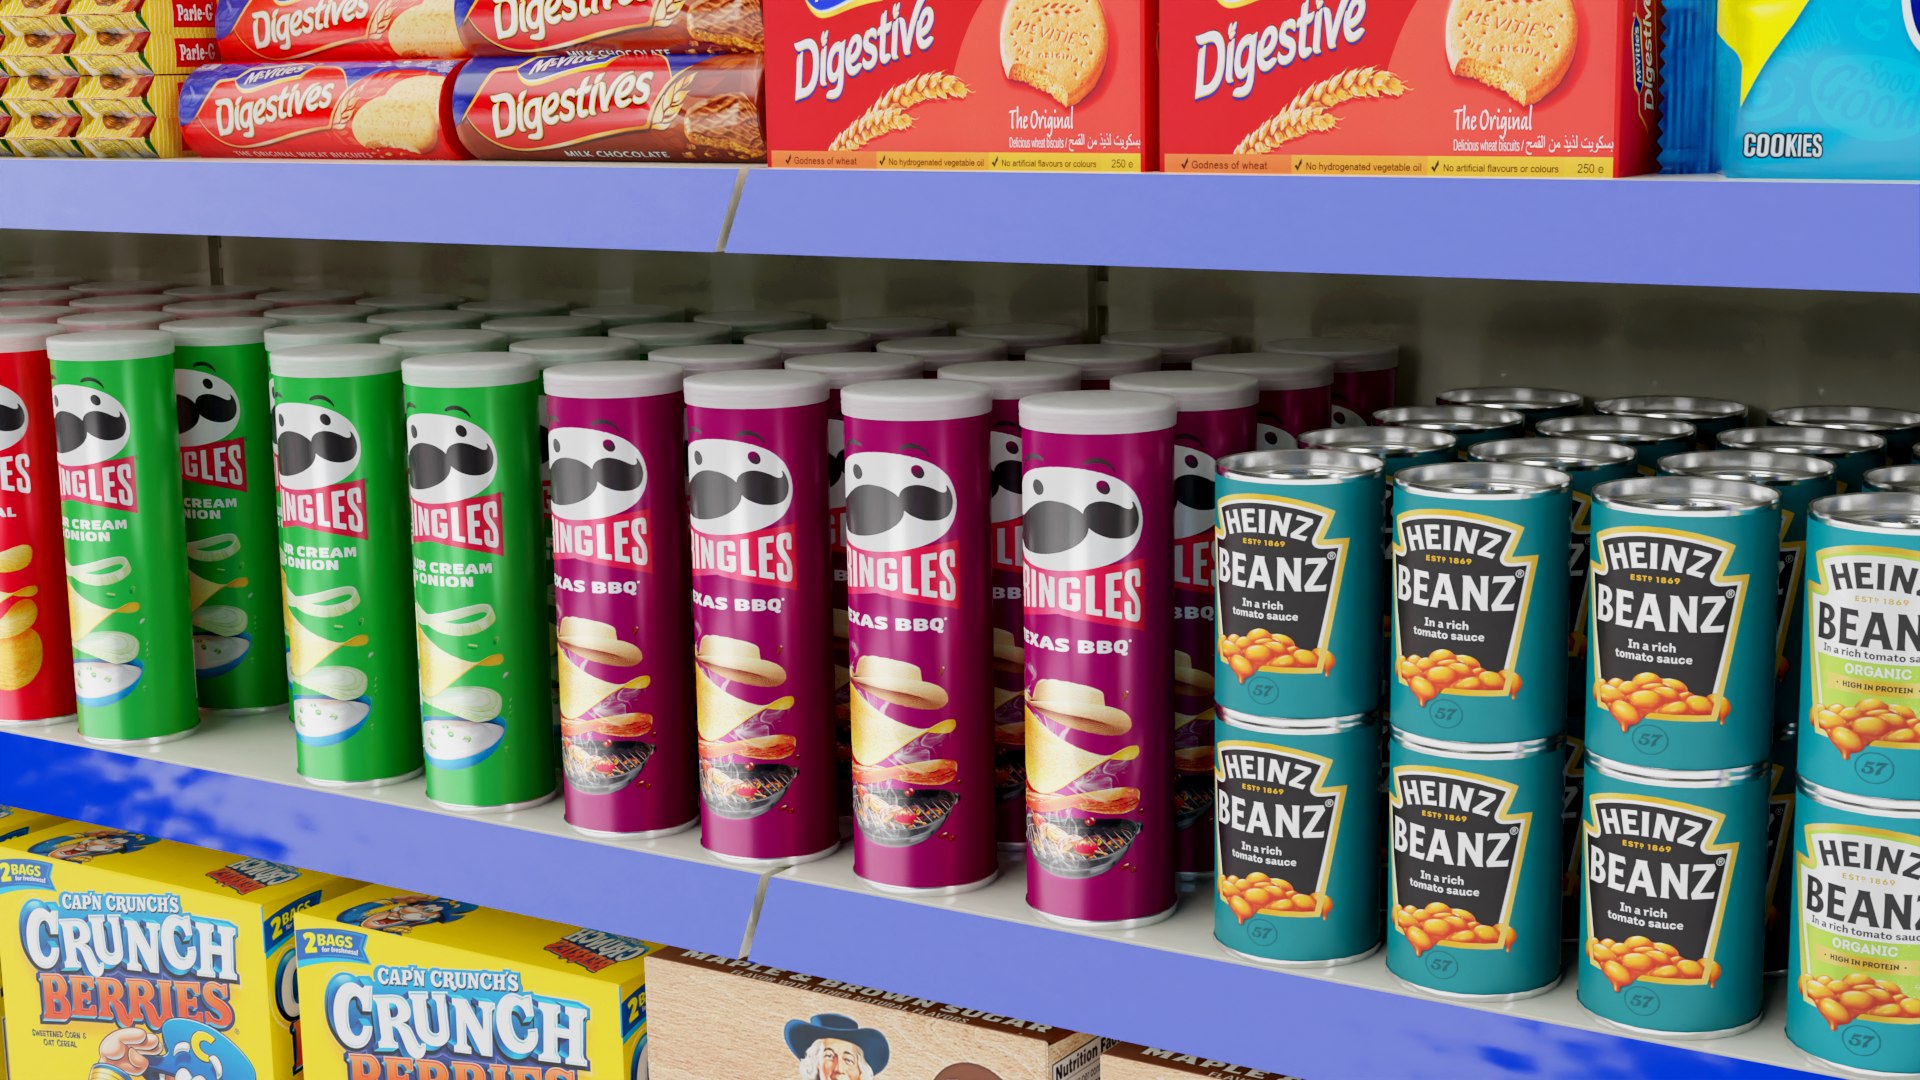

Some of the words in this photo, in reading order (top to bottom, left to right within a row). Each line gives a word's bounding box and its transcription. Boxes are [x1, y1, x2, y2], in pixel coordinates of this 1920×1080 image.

[793, 2, 935, 102] Digestive
[1194, 0, 1367, 101] Digestive
[215, 82, 335, 138] Digestives
[490, 70, 654, 140] Digestives
[1008, 106, 1028, 130] The
[1030, 106, 1074, 137] Original
[1453, 104, 1477, 130] The
[1480, 104, 1533, 139] Original
[1743, 132, 1823, 158] COOKIES
[564, 150, 594, 158] MILK
[596, 150, 670, 159] CHOCOLATE
[794, 156, 824, 165] Godness
[827, 156, 834, 165] of
[836, 157, 856, 166] wheat
[888, 158, 898, 166] No
[1112, 159, 1126, 168] 250
[1192, 160, 1229, 170] Godness
[1231, 160, 1240, 170] of
[1242, 161, 1268, 170] wheat
[1306, 162, 1316, 171] No
[1318, 162, 1370, 173] hydrogenated
[1373, 162, 1410, 174] vegetable
[1412, 163, 1422, 172] oil
[1443, 164, 1454, 172] No
[1456, 164, 1486, 173] artificial
[1487, 164, 1518, 173] flavours
[1530, 164, 1559, 174] colours
[1577, 163, 1594, 174] 250
[72, 518, 128, 530] CREAM
[1224, 508, 1314, 542] HEINZ
[1406, 524, 1502, 559] HEINZ
[296, 546, 356, 558] CREAM
[1608, 542, 1713, 578] HEINZ
[288, 556, 339, 570] ONION
[430, 562, 492, 574] CREAM
[420, 572, 474, 588] ONION
[1232, 605, 1264, 620] tomato
[1266, 610, 1298, 622] sauce
[1412, 625, 1448, 640] tomato
[1450, 631, 1485, 642] sauce
[1615, 648, 1654, 664] tomato
[1656, 654, 1693, 666] sauce
[1844, 662, 1912, 680] ORGANIC
[1252, 684, 1274, 698] 57
[1842, 680, 1862, 690] HIGH
[1876, 684, 1914, 694] PROTEIN
[1435, 706, 1457, 721] 57
[1638, 733, 1662, 746] 57
[1224, 755, 1312, 790] HEINZ
[1860, 761, 1886, 776] 57
[1402, 780, 1498, 818] HEINZ
[1600, 808, 1703, 848] HEINZ
[1232, 848, 1264, 864] tomato
[1265, 856, 1297, 867] sauce
[11, 864, 41, 877] BAGS
[1409, 876, 1444, 893] tomato
[1446, 886, 1480, 898] sauce
[105, 894, 180, 914] CRUNCH'S
[1607, 909, 1646, 927] tomato
[1648, 920, 1684, 931] sauce
[1252, 926, 1272, 940] 57
[25, 907, 239, 981] CRUNCH
[302, 932, 318, 954] 2
[316, 934, 353, 948] BAGS
[1832, 936, 1898, 958] ORGANIC
[1431, 958, 1452, 972] 57
[1830, 954, 1850, 964] HIGH
[1852, 957, 1861, 966] IN
[1862, 958, 1900, 970] PROTEIN
[430, 968, 520, 992] CRUNCH'S
[680, 949, 786, 977] MAPLE
[789, 973, 812, 982] &
[818, 979, 938, 1008] BROWN
[940, 1003, 1054, 1033] SUGAR
[40, 973, 234, 1030] BERRIES
[1630, 994, 1653, 1008] 57
[332, 982, 589, 1068] CRUNCH
[1848, 1034, 1874, 1048] 57
[1055, 1046, 1098, 1080] Nutrition
[1140, 1047, 1270, 1080] MAPLE
